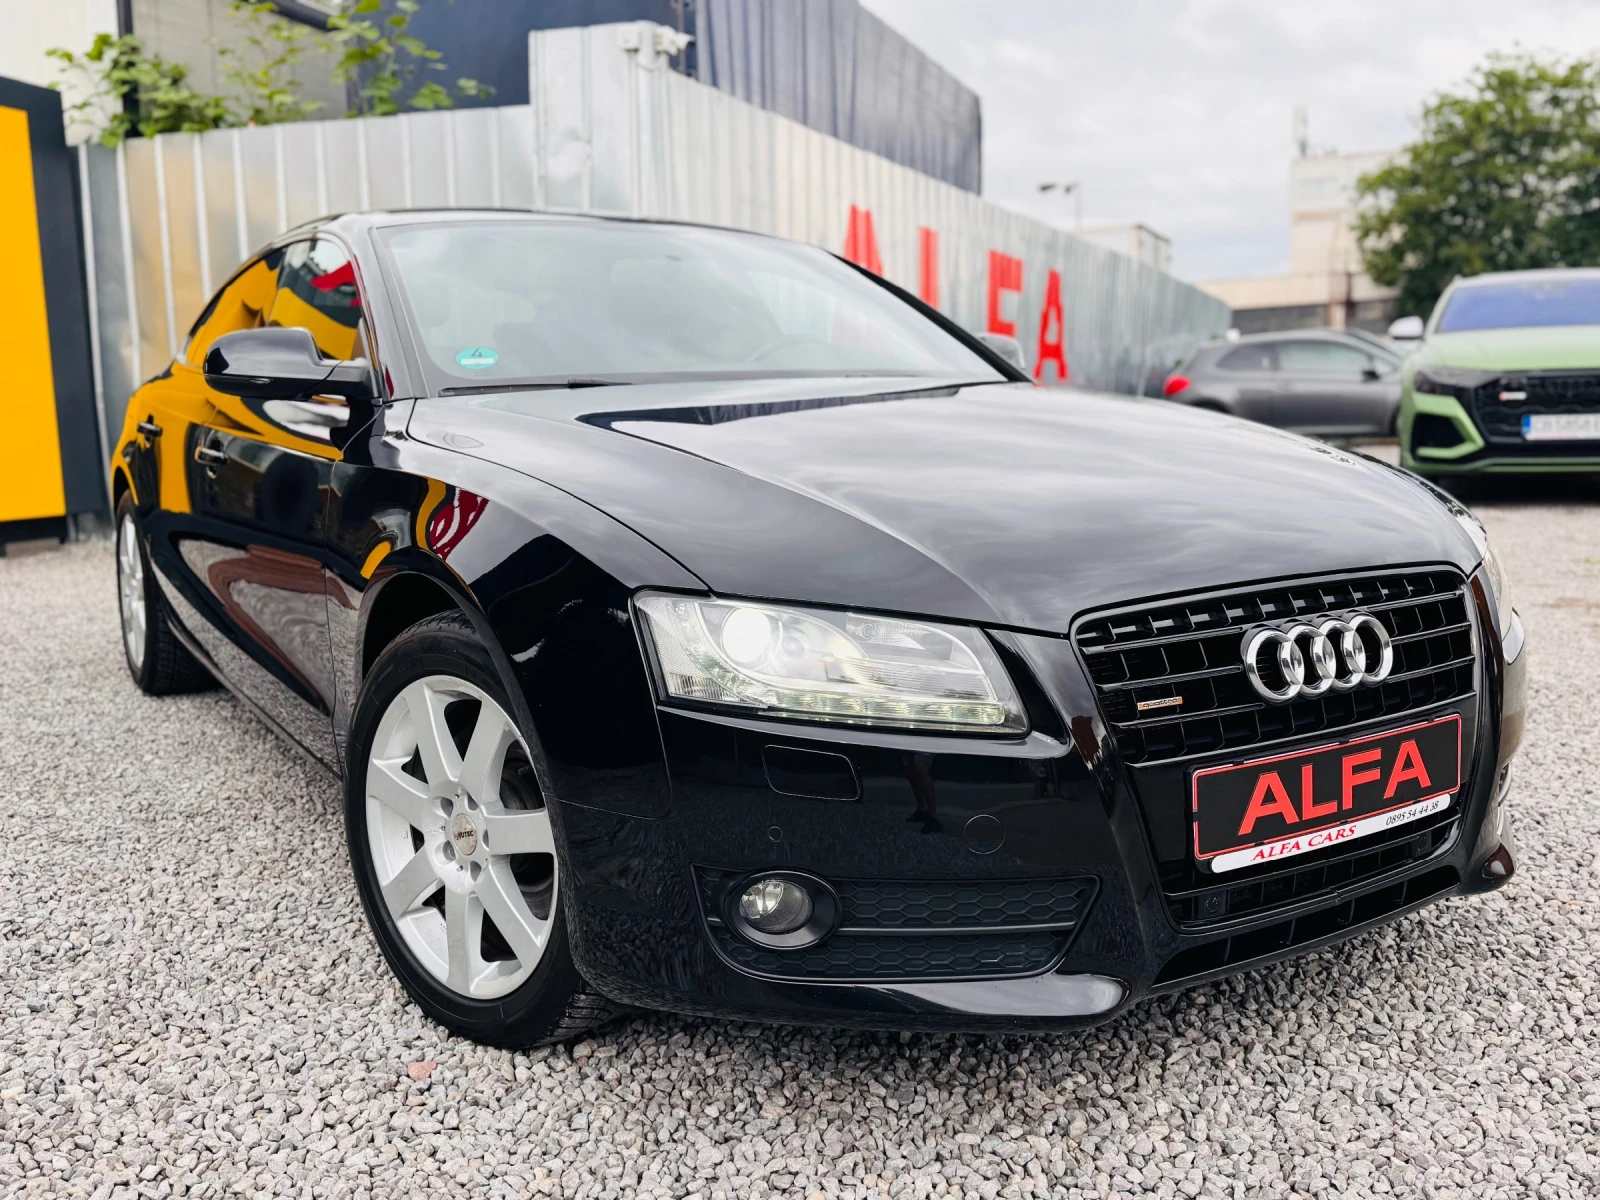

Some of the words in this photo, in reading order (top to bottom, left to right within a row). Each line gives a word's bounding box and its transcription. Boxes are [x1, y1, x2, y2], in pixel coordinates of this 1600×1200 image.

[471, 347, 483, 358] 4
[1142, 698, 1178, 708] quattro
[1238, 740, 1432, 836] ALFA
[1385, 811, 1407, 826] 0895
[1407, 808, 1417, 819] 54
[1419, 804, 1429, 815] 44
[1250, 840, 1302, 861] ALFA
[1307, 825, 1356, 847] CARS
